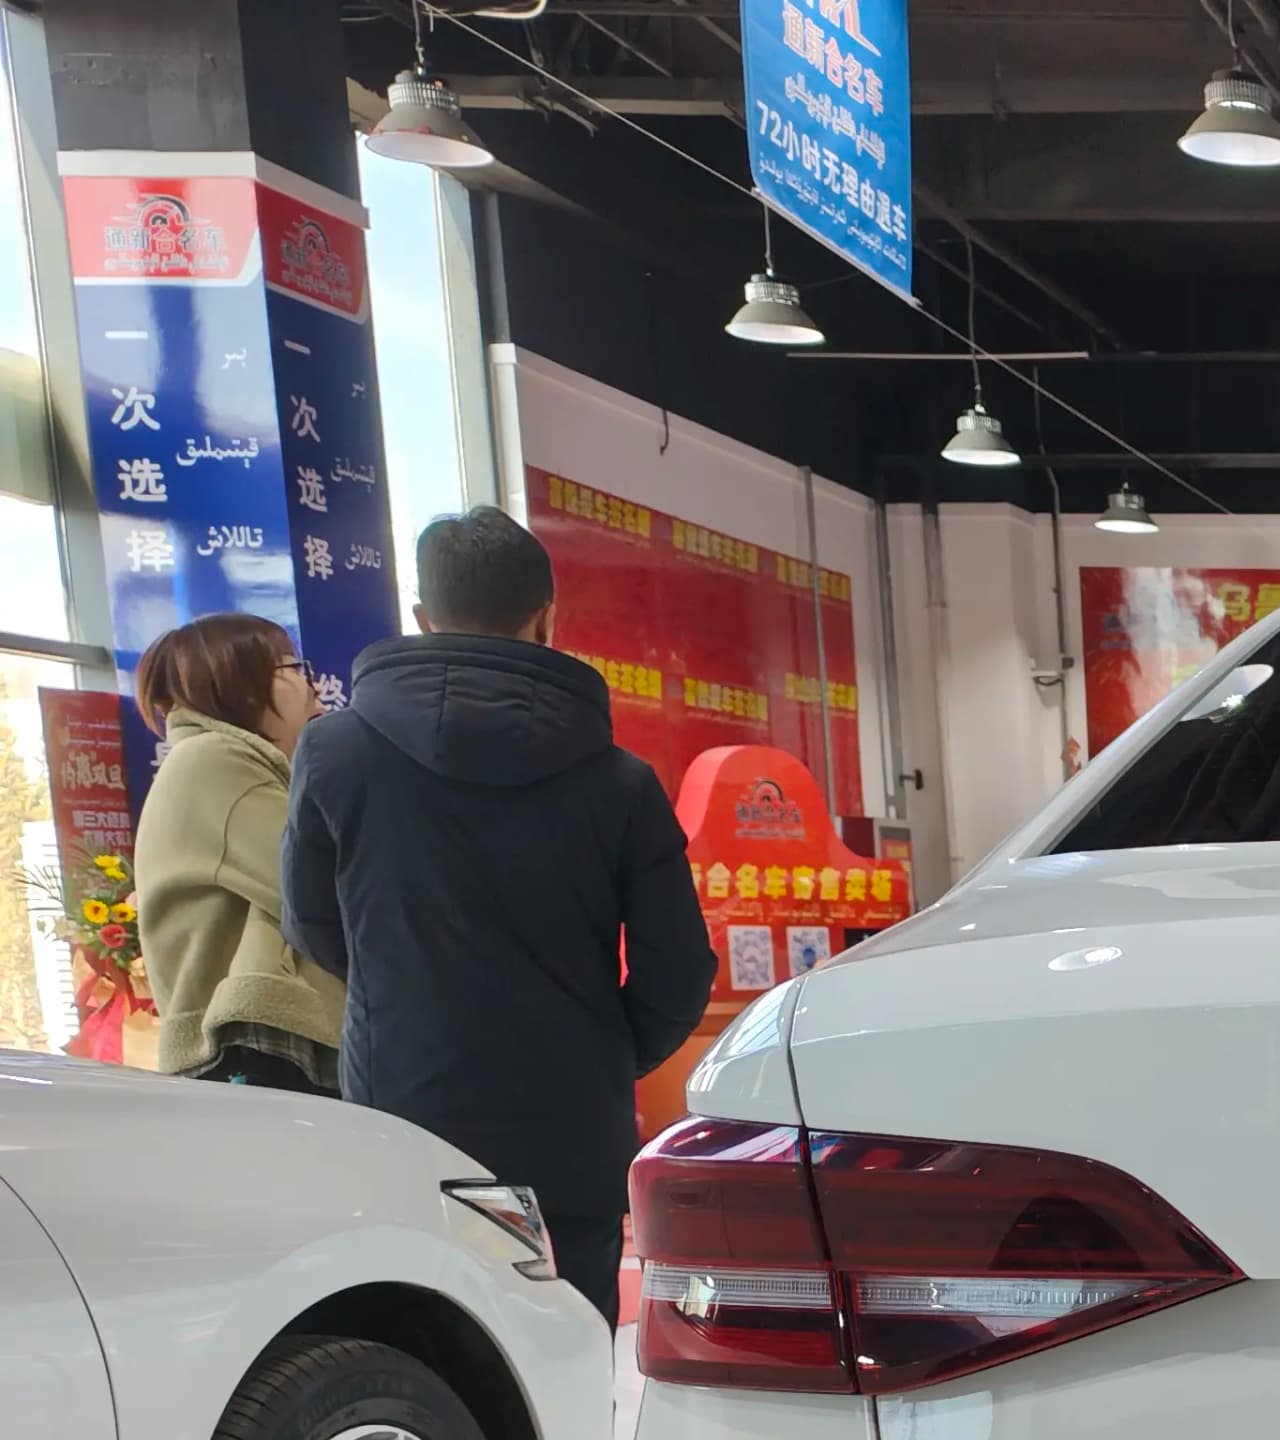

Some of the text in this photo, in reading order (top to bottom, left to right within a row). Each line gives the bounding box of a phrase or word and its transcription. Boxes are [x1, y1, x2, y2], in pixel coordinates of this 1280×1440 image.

[756, 100, 907, 242] 72小时无理由退车
